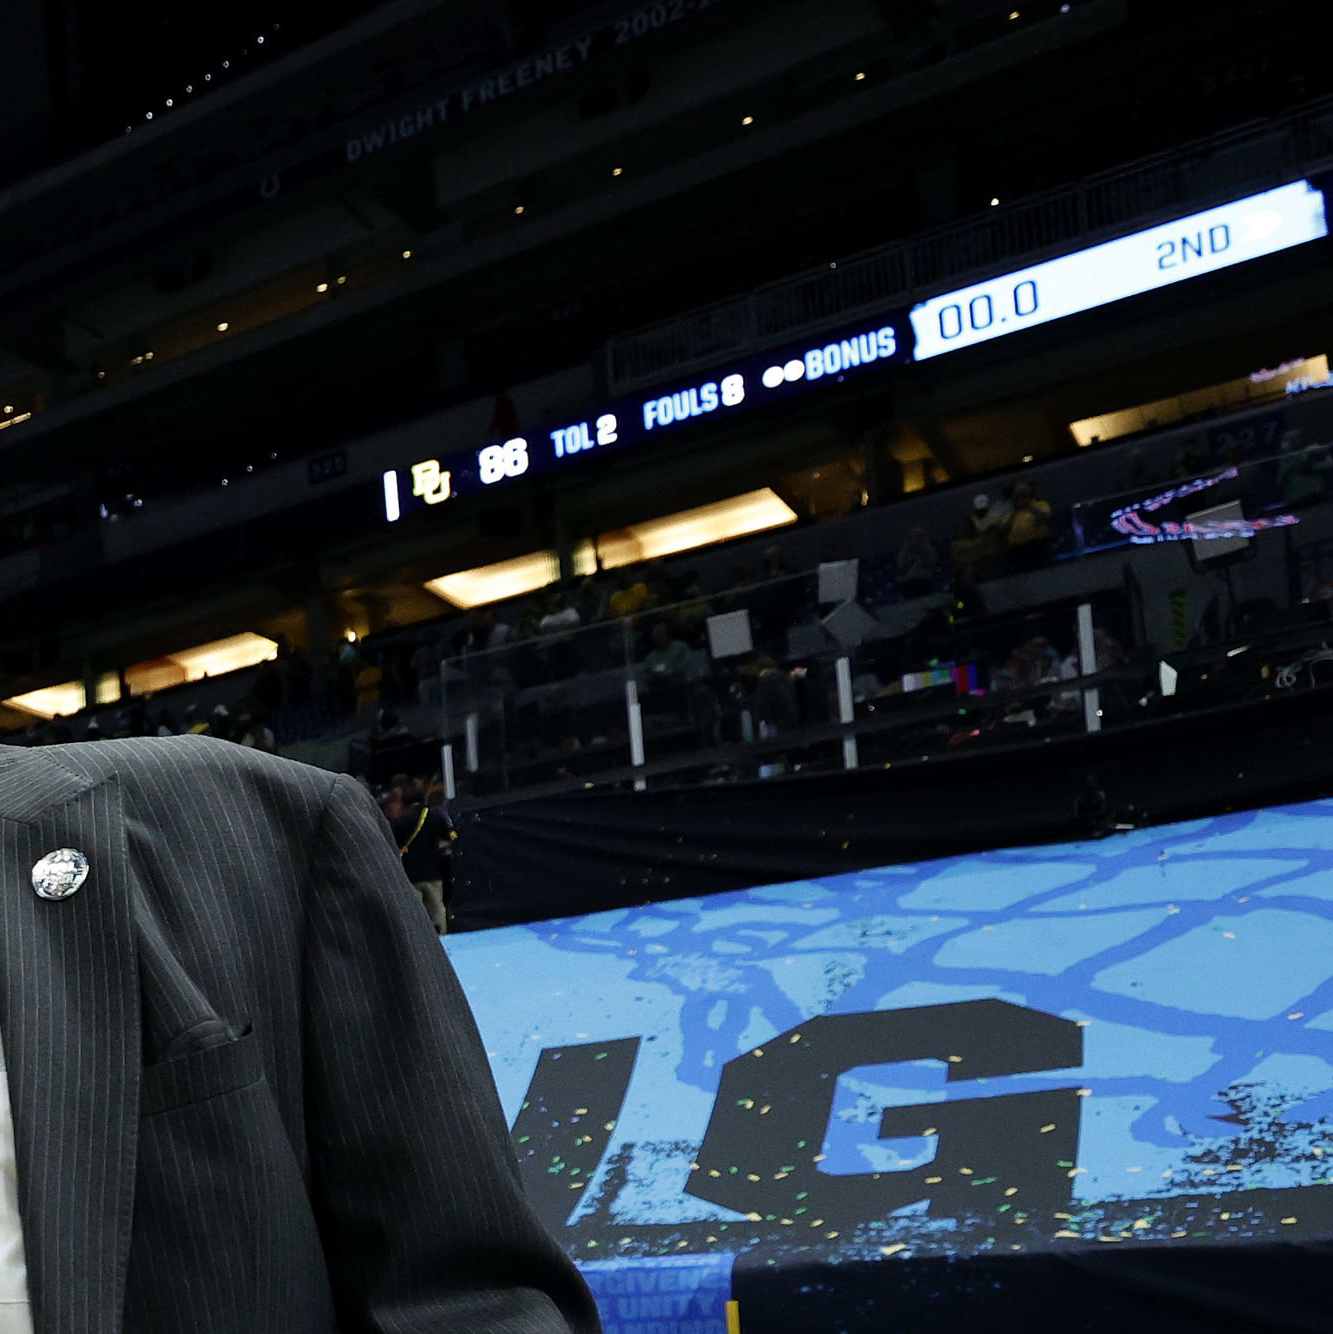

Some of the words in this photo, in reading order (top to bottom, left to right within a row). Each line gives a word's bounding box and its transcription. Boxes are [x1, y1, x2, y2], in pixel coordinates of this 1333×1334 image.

[345, 98, 449, 161] DWIGHT
[461, 36, 593, 112] FREENEY
[1156, 223, 1231, 270] 2ND
[939, 280, 1038, 341] 00.0
[478, 437, 529, 484] 86
[550, 422, 594, 457] TOL
[596, 414, 617, 446] 2
[643, 383, 718, 430] FOULS
[804, 327, 896, 381] BONUS
